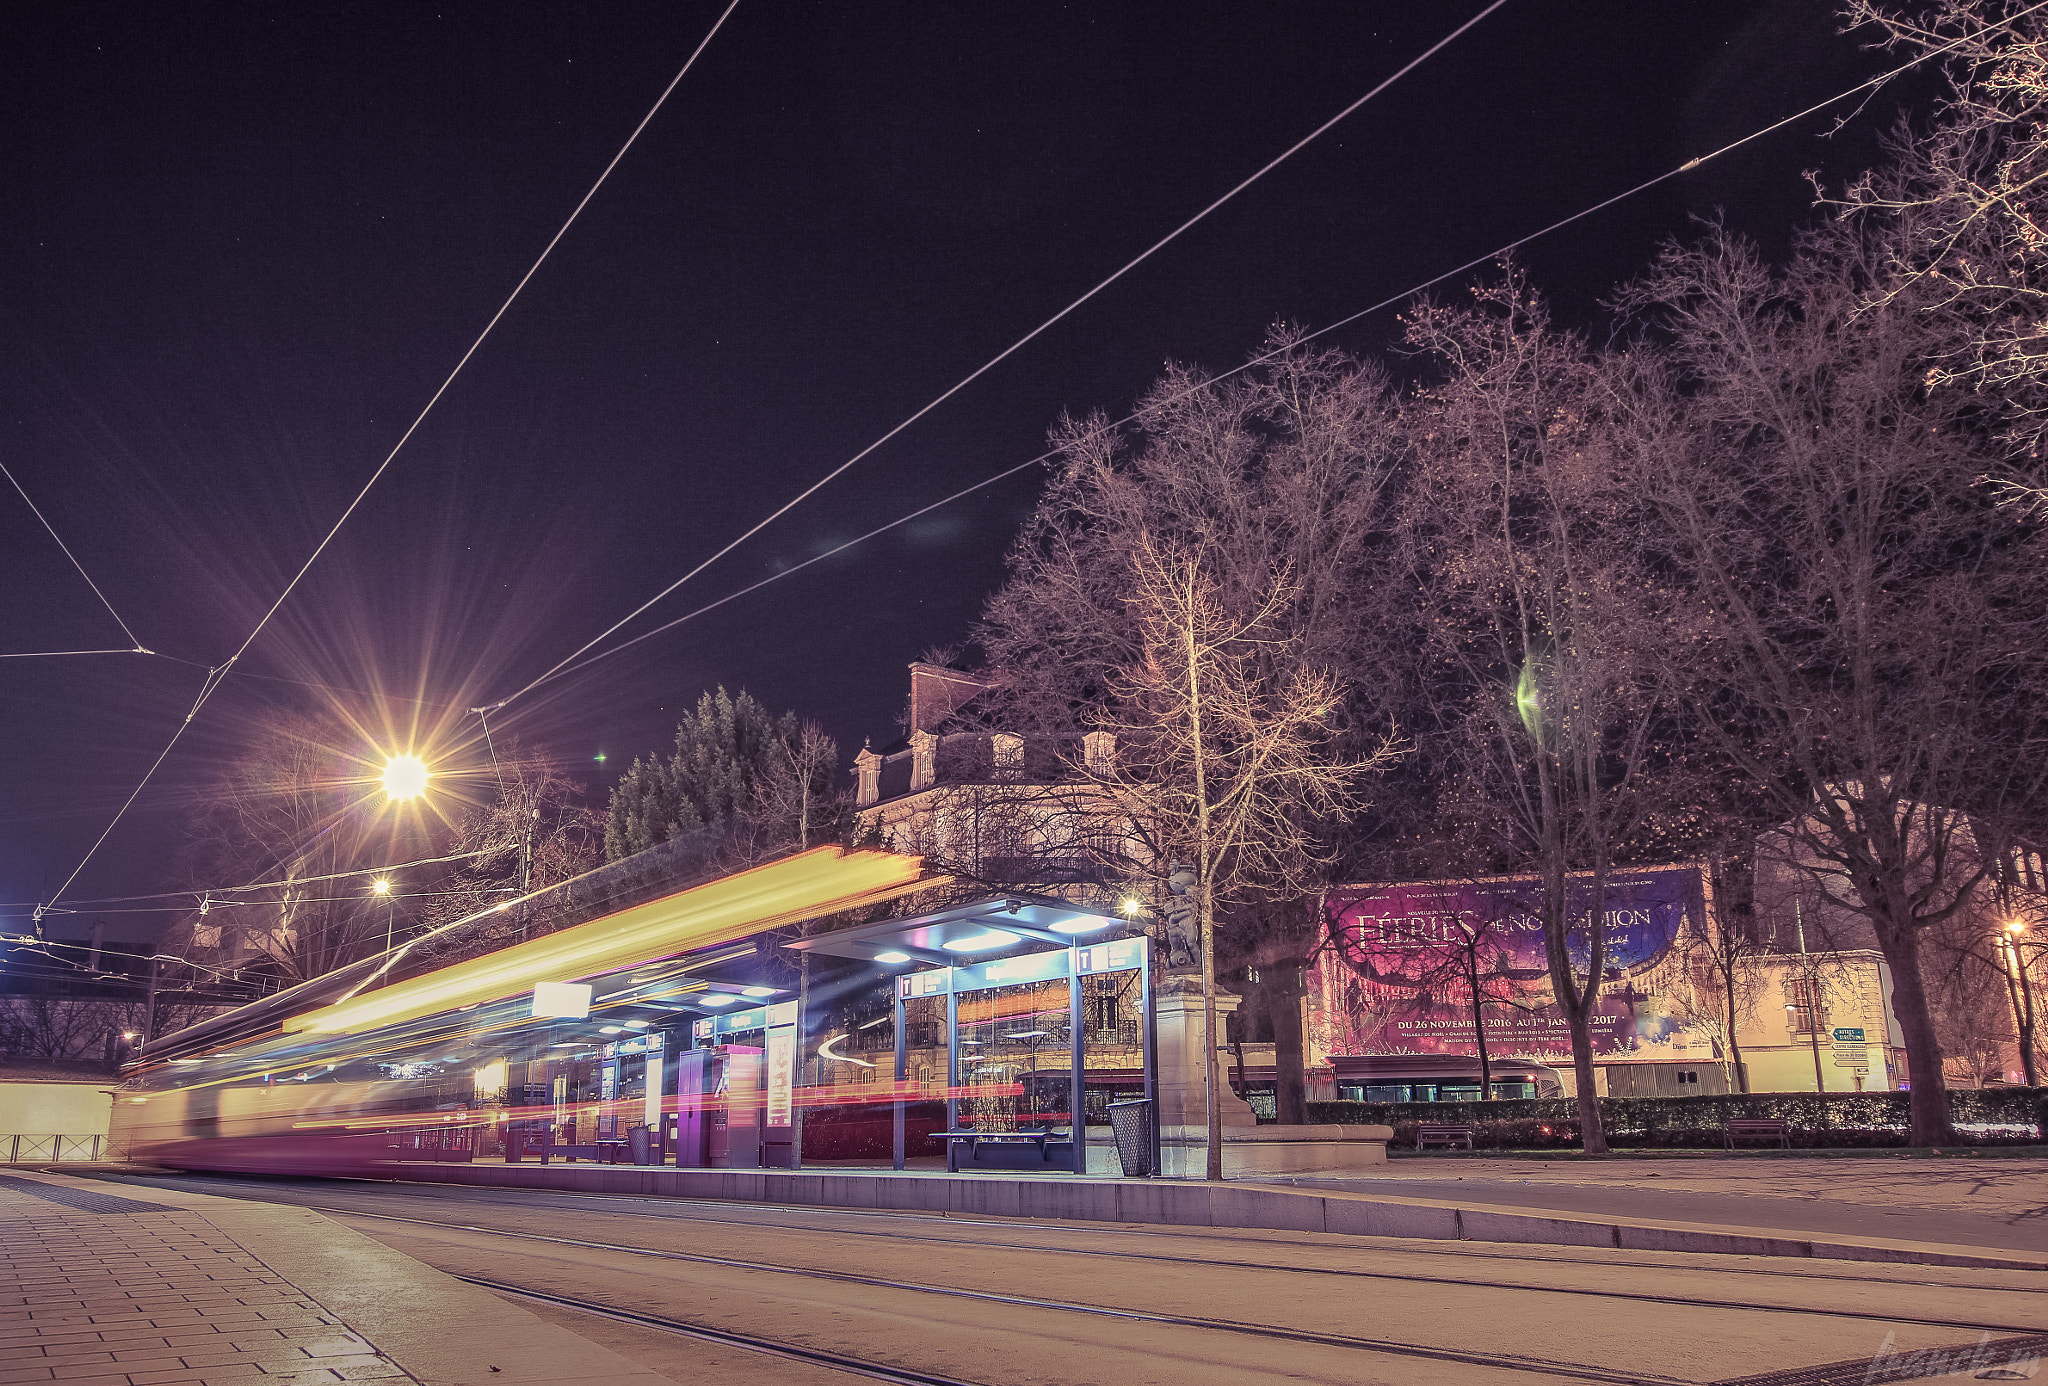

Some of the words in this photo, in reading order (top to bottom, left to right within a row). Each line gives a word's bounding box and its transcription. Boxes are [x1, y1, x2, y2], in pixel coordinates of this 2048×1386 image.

[1355, 911, 1477, 948] FÉERIES
[1398, 1021, 1412, 1029] DU
[1415, 1020, 1428, 1029] 26
[1488, 1018, 1512, 1028] 2016
[1516, 1019, 1531, 1027] AU
[1593, 1015, 1617, 1025] 2017
